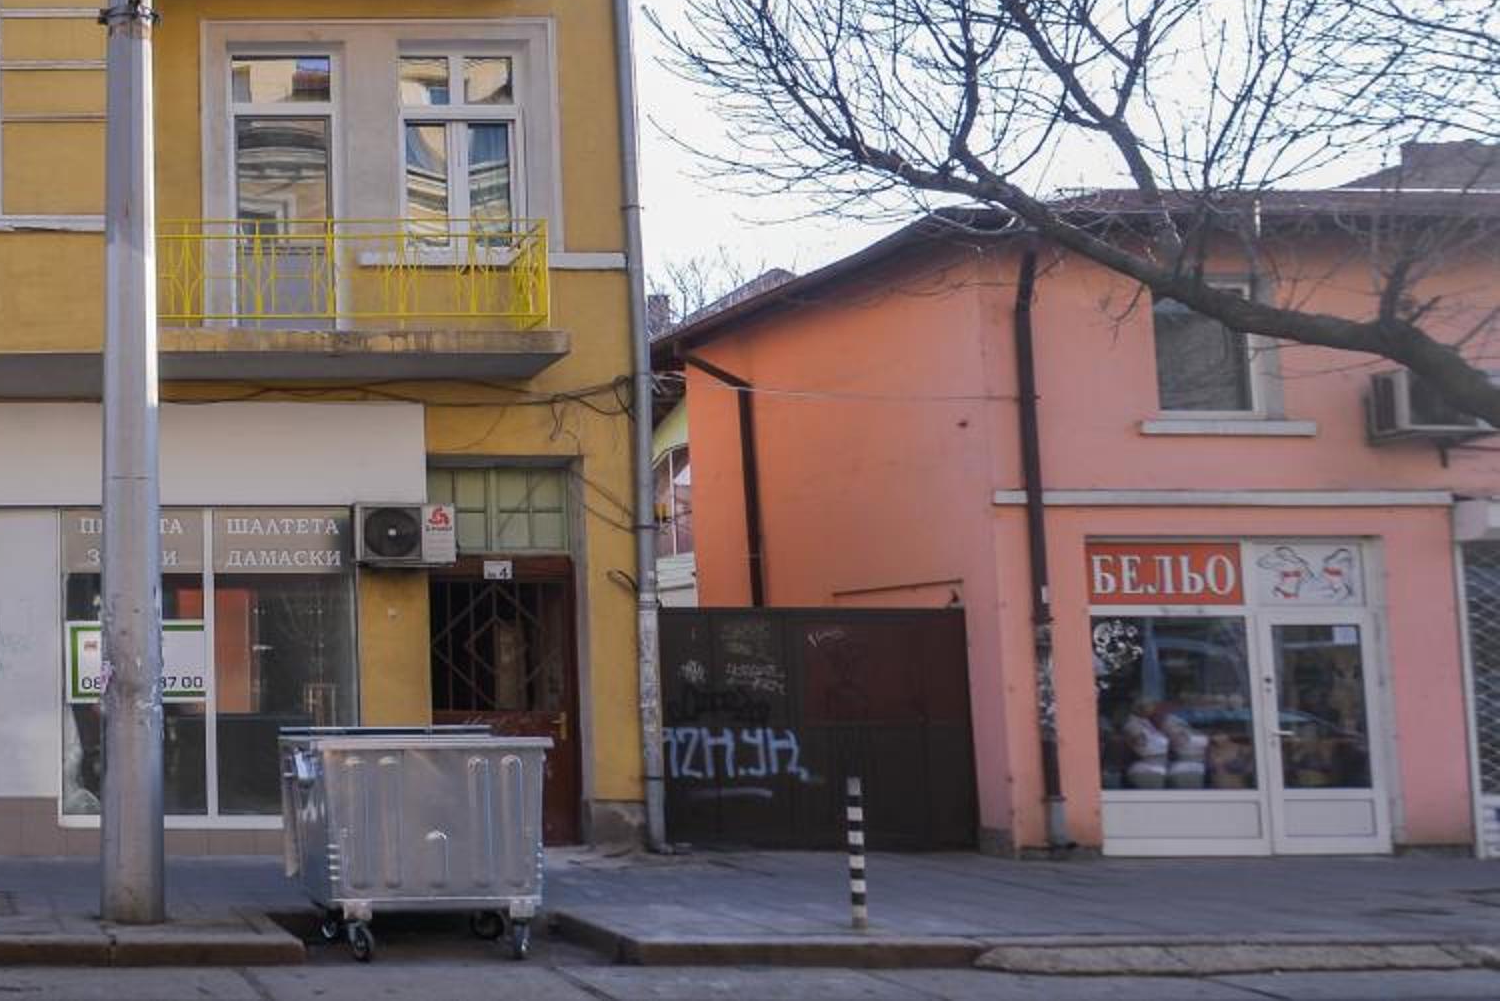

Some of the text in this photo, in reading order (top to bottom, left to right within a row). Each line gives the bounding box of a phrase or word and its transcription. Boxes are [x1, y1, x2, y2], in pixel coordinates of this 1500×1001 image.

[226, 517, 340, 536] ШАЛТЕТА
[226, 549, 342, 568] ДАМАСКИ
[1091, 554, 1235, 595] БЕЛЬО
[181, 676, 203, 689] 00
